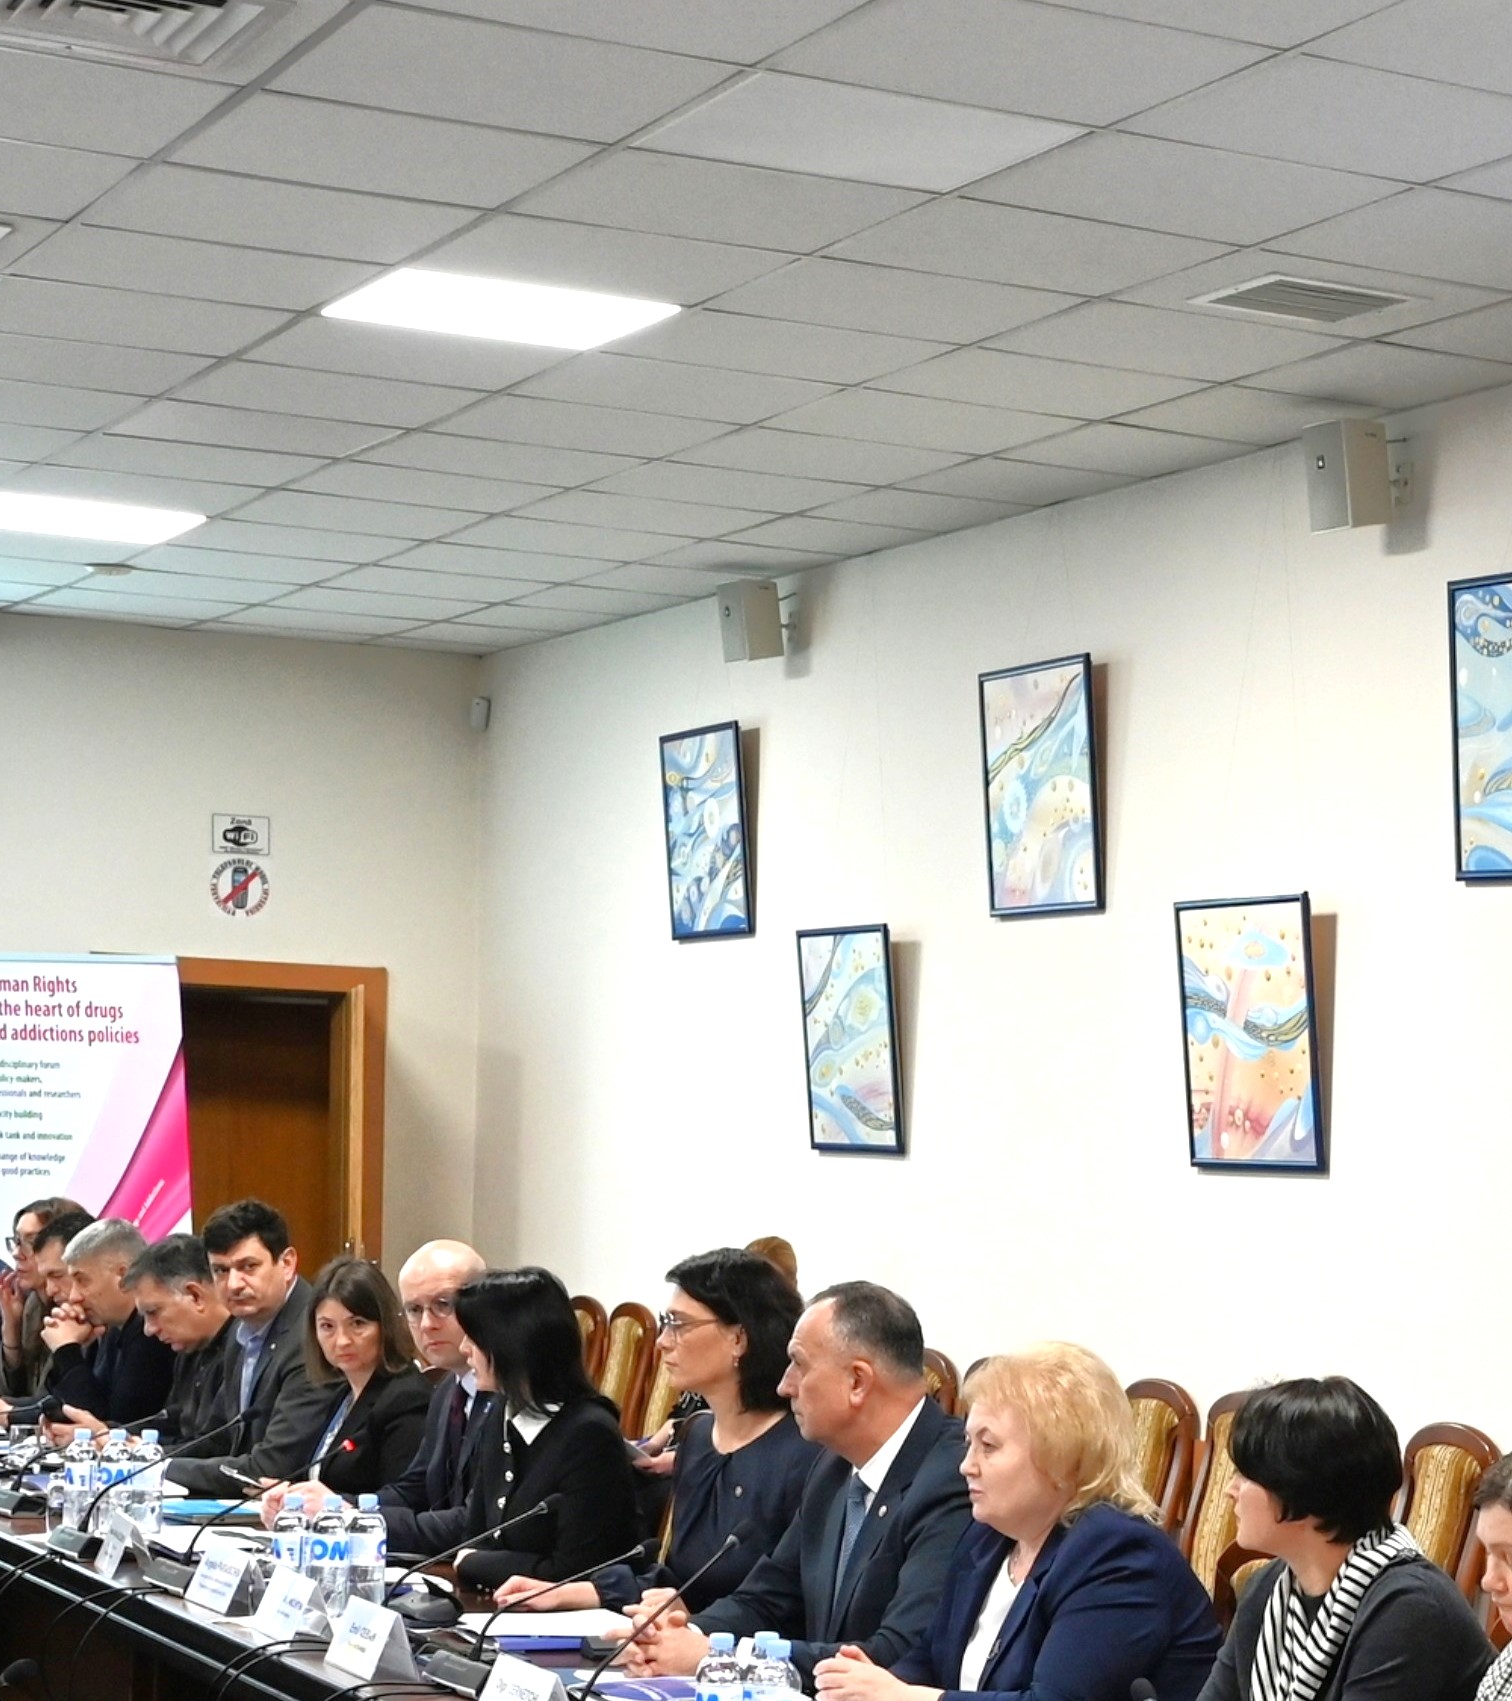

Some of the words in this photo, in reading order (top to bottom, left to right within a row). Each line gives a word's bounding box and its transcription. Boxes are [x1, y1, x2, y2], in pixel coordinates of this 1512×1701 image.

[33, 975, 78, 997] Rights
[25, 1000, 63, 1018] heart
[67, 1001, 81, 1018] of
[85, 1001, 124, 1023] drugs
[11, 1024, 84, 1043] addictions
[88, 1026, 140, 1047] policies
[39, 1060, 61, 1069] forum
[29, 1088, 42, 1098] and
[44, 1090, 81, 1098] researchers
[14, 1109, 43, 1121] building
[5, 1131, 20, 1139] tank
[23, 1131, 35, 1140] and
[37, 1132, 73, 1140] innovation
[20, 1152, 27, 1160] of
[28, 1152, 65, 1164] knowledge
[2, 1167, 18, 1177] good
[20, 1168, 50, 1177] practices
